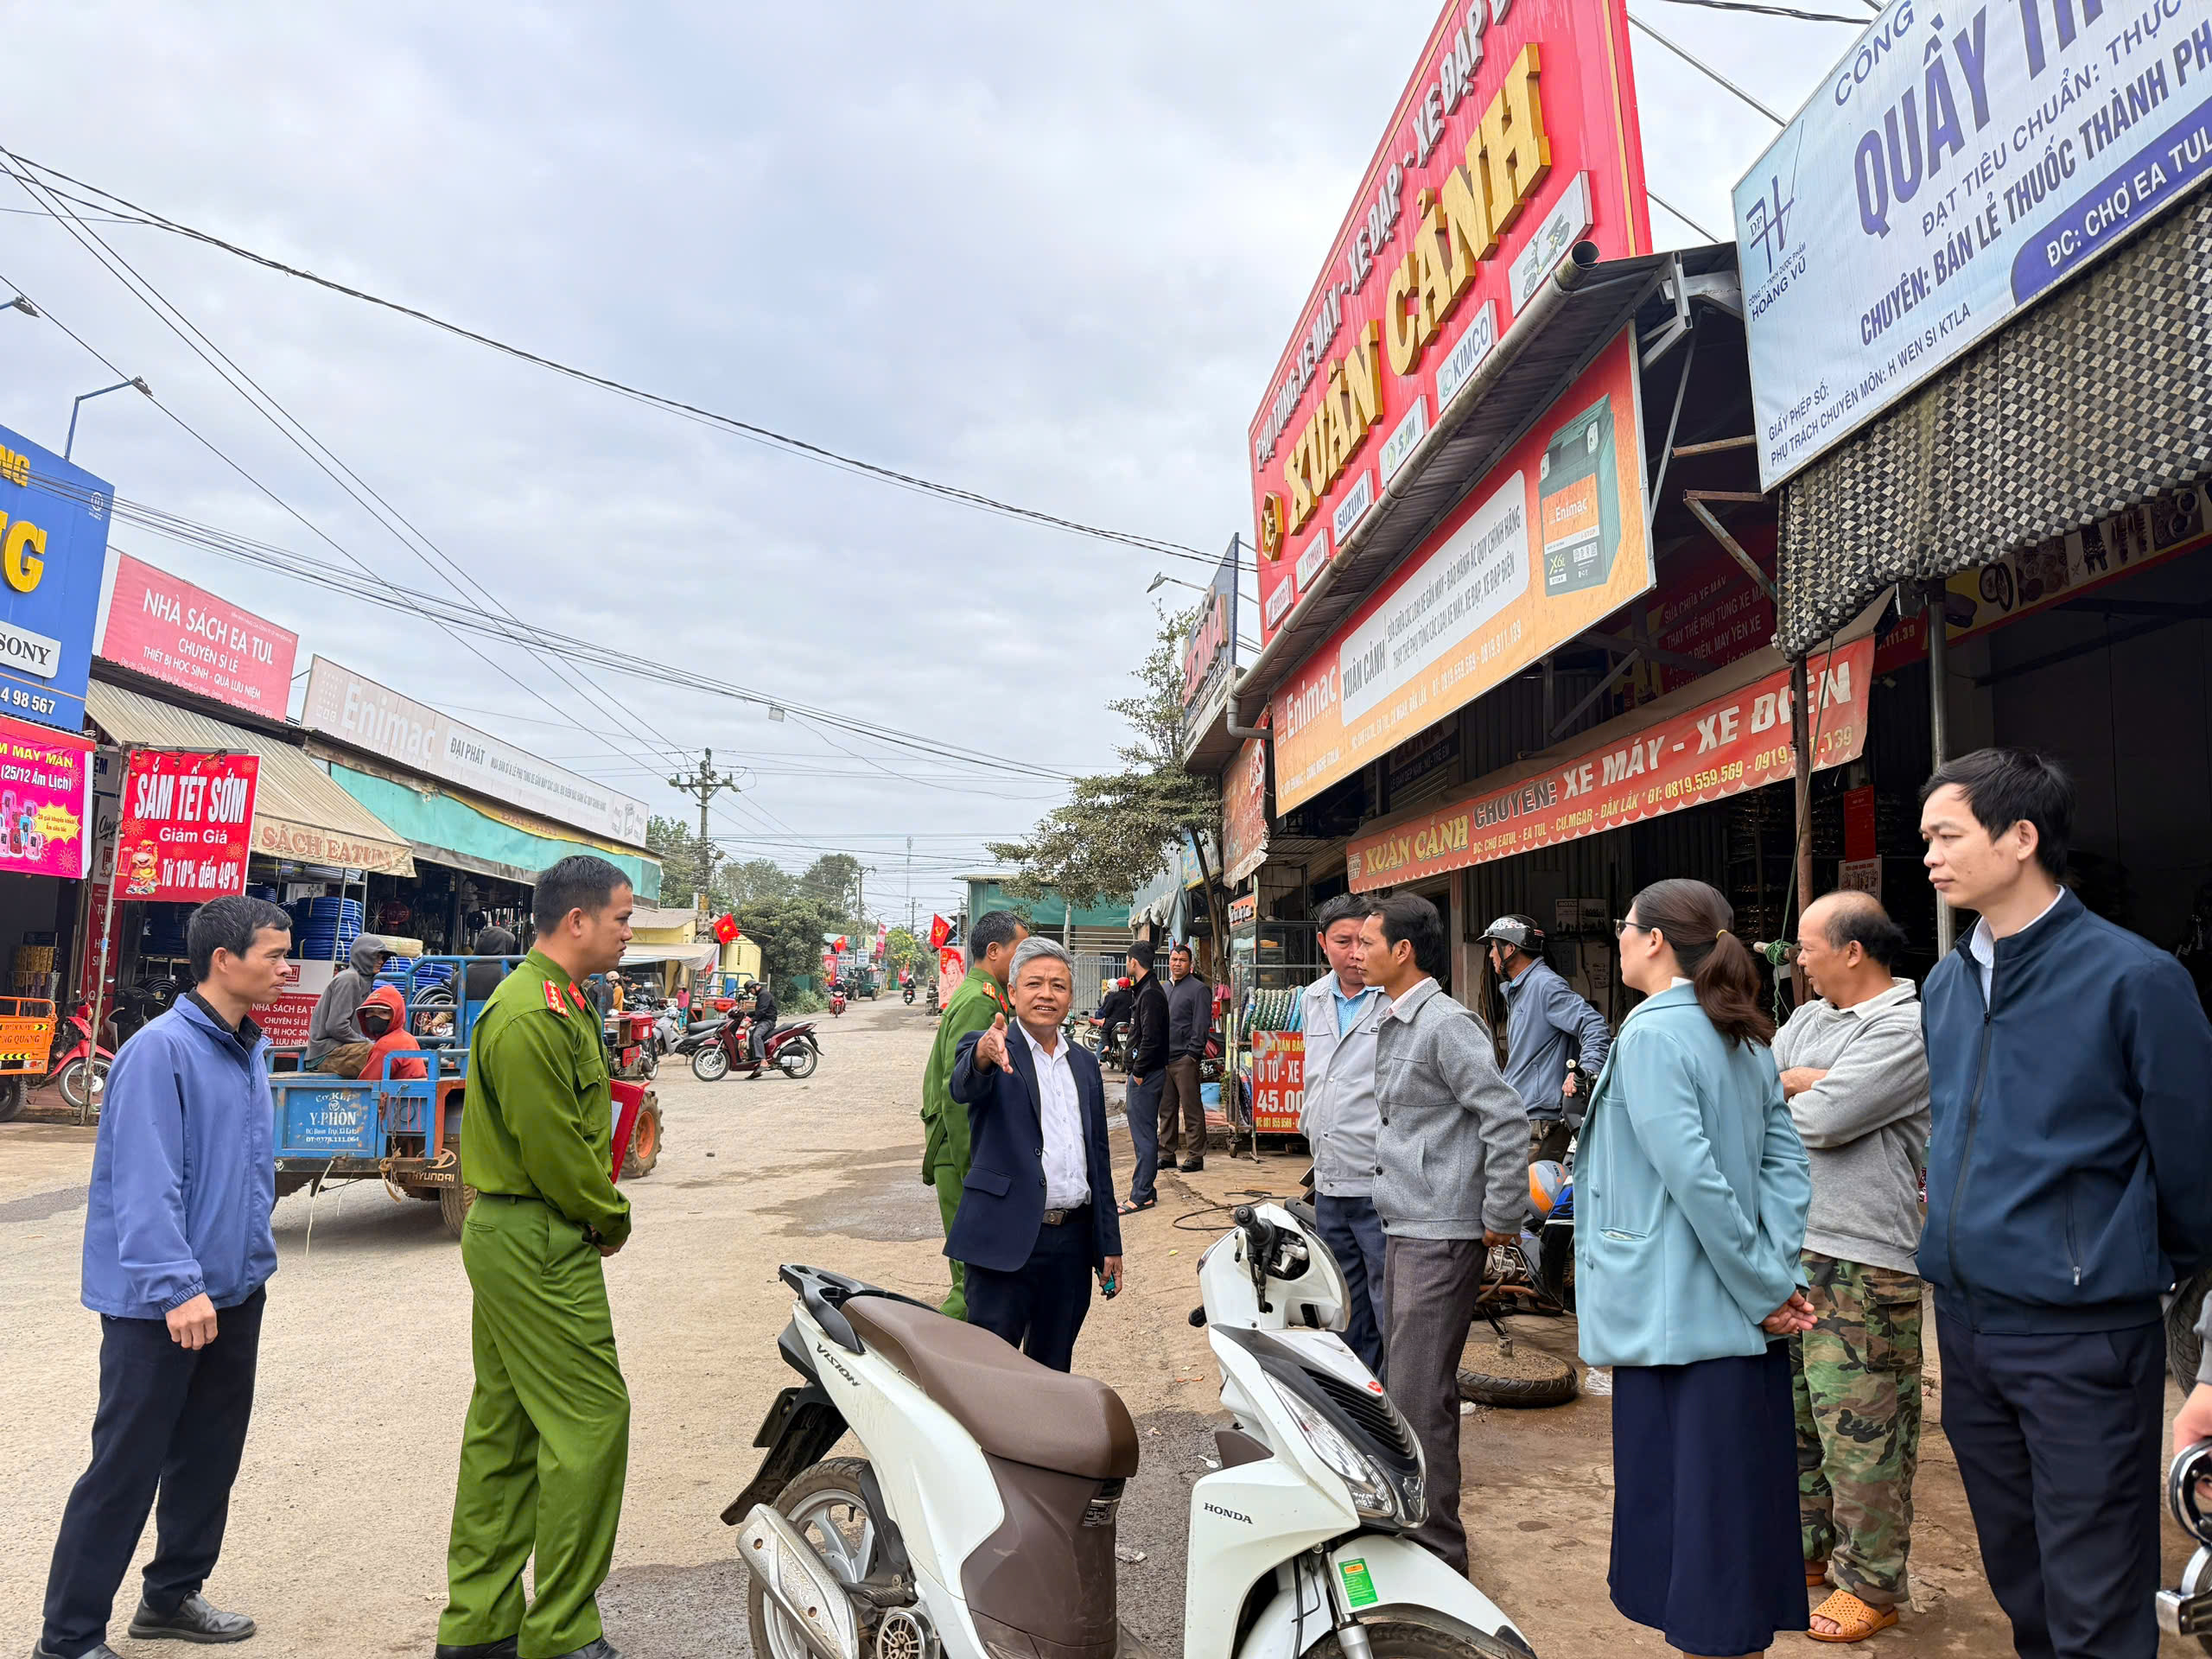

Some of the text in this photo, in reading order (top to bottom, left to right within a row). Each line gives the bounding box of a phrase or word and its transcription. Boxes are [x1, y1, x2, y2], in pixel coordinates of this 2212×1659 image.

[1834, 3, 1916, 107] CÔNG
[1853, 4, 1990, 239] QUẦY
[1921, 63, 2101, 238] ĐẠT TIÊU CHUẨN:
[1296, 335, 1316, 394] XE
[1313, 281, 1343, 365] MÁY
[1347, 225, 1373, 296] XE
[1367, 162, 1404, 257] ĐẠP
[1412, 81, 1446, 169] XE
[1439, 0, 1489, 117] ĐẠP
[1860, 262, 1932, 347] CHUYÊN:
[1932, 224, 1973, 289] BÁN
[1978, 192, 2005, 251] LẺ
[2004, 135, 2075, 226] THUỐC
[2078, 58, 2170, 162] THÀNH
[2046, 228, 2082, 268] ĐC:
[2084, 181, 2131, 238] CHỢ
[2133, 162, 2167, 202] EA
[1284, 42, 1553, 537] XUÂN CẢNH
[1751, 254, 1806, 322] HOÀNG VŨ
[1452, 316, 1490, 385] KIMCO
[1768, 378, 1830, 442] GIẤY PHÉP SỐ:
[1770, 302, 1972, 467] PHỤ TRÁCH CHUYÊN MÔN: H WEN SI KTLA
[1337, 485, 1366, 534] SUZUKI
[1555, 499, 1588, 522] Enimac
[1405, 603, 1414, 628] CÁC
[1421, 594, 1427, 614] XE
[1446, 562, 1457, 592] BẢO
[1456, 553, 1471, 583] HÀNH
[1487, 522, 1504, 555] CHÍNH
[1503, 505, 1521, 541] HÃNG
[1428, 615, 1437, 640] CÁC
[1437, 612, 1447, 635] LOẠI
[1446, 605, 1453, 627] XE
[1465, 588, 1471, 612] XE
[1483, 575, 1491, 598] XE
[1490, 564, 1502, 595] ĐẠP
[1501, 550, 1516, 584] ĐIỆN
[143, 588, 181, 626] NHÀ
[186, 606, 227, 645] SÁCH
[230, 628, 248, 655] EA
[252, 636, 274, 665] TUL
[1667, 590, 1751, 651] THAY THẾ PHỤ TÙNG XE
[1714, 630, 1730, 652] MAY
[1731, 617, 1749, 645] YÊN
[1749, 614, 1762, 637] XE
[143, 645, 164, 664] THIẾT
[164, 654, 172, 667] BỊ
[173, 657, 189, 674] HỌC
[191, 664, 209, 680] SINH
[213, 673, 230, 690] QUÀ
[231, 677, 244, 695] LƯU
[245, 683, 261, 701] NIỆM
[178, 638, 217, 666] CHUYÊN
[228, 657, 238, 674] LẺ
[1342, 638, 1388, 702] XUÂN CẢNH
[12, 690, 56, 715] 98 567
[341, 683, 436, 761] Enimac
[1287, 664, 1338, 740] Enimac
[1, 764, 73, 792] (25/12 Âm Lịch)
[12, 745, 73, 769] MAY MẮN
[450, 737, 486, 766] ĐẠI PHÁT
[1471, 704, 1741, 830] CHUYÊN: XE MÁY XE
[134, 755, 249, 824] SẮM TẾT SỚM
[1472, 841, 1484, 855] ĐC:
[1484, 834, 1497, 852] CHỢ
[1497, 830, 1518, 850] EATUL
[1522, 828, 1534, 843] EA
[1534, 824, 1547, 840] TUL
[1599, 798, 1619, 820] ĐẮK
[1619, 792, 1640, 815] LẮK
[1646, 785, 1662, 805] ĐT:
[1664, 764, 1744, 799] 0819.559.569
[159, 826, 228, 845] Giảm Giá
[261, 823, 323, 858] SÁCH
[1364, 832, 1411, 876] XUÂN
[1414, 814, 1469, 862] CẢNH
[162, 855, 240, 891] Từ 10% đến 49%
[264, 1015, 292, 1026] CHUYÊN
[273, 1001, 296, 1014] SÁCH
[297, 1006, 308, 1014] EA
[273, 1027, 297, 1038] BỊ HỌC
[1267, 1054, 1300, 1084] TÔ XE
[1278, 1037, 1291, 1052] BÁN
[816, 1340, 861, 1388] VISION
[1204, 1501, 1254, 1526] HONDA
